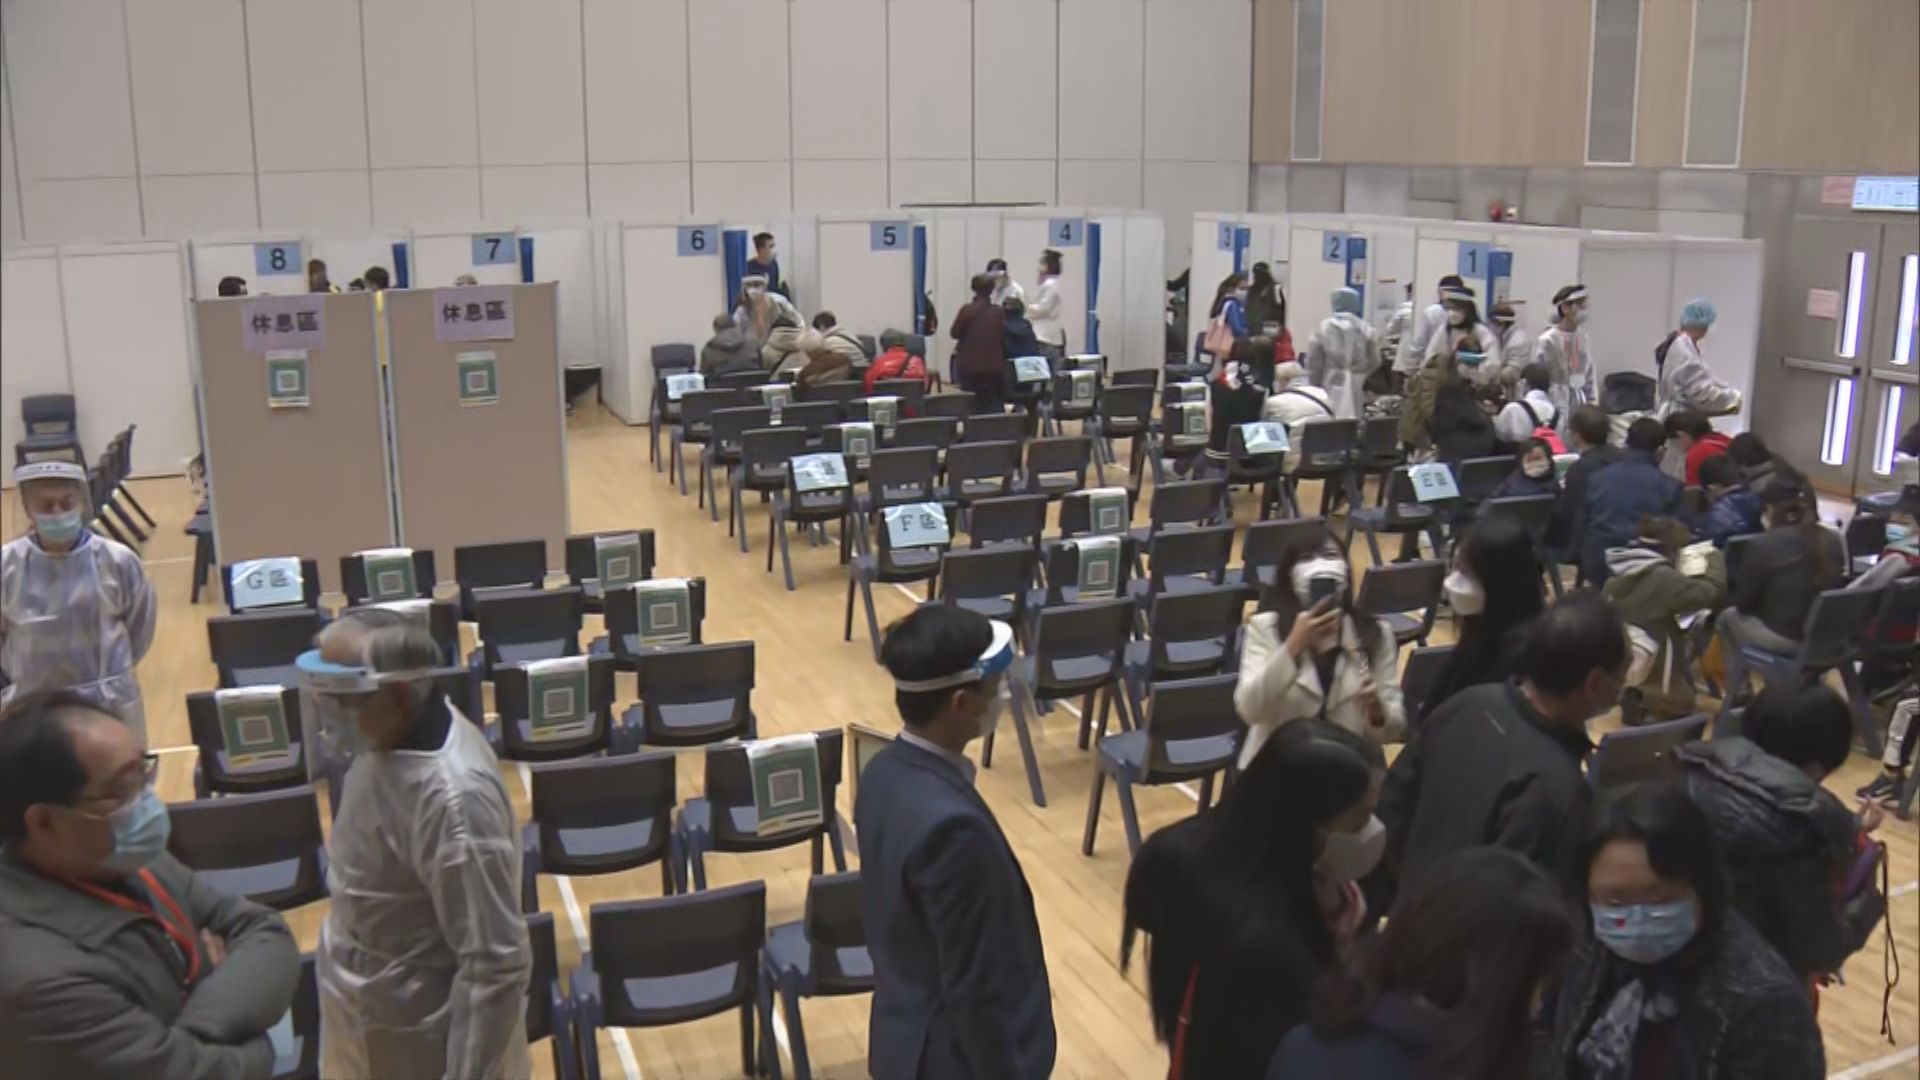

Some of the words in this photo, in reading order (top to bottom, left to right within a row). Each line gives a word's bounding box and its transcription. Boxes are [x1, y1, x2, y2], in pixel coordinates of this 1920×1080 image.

[691, 230, 705, 251] 6
[883, 226, 896, 246] 5
[1060, 223, 1071, 241] 4
[485, 238, 501, 260] 7
[1329, 236, 1341, 258] 2
[271, 248, 286, 270] 8
[1467, 248, 1477, 273] 1
[443, 300, 506, 323] 休息區
[252, 311, 318, 335] 休息區
